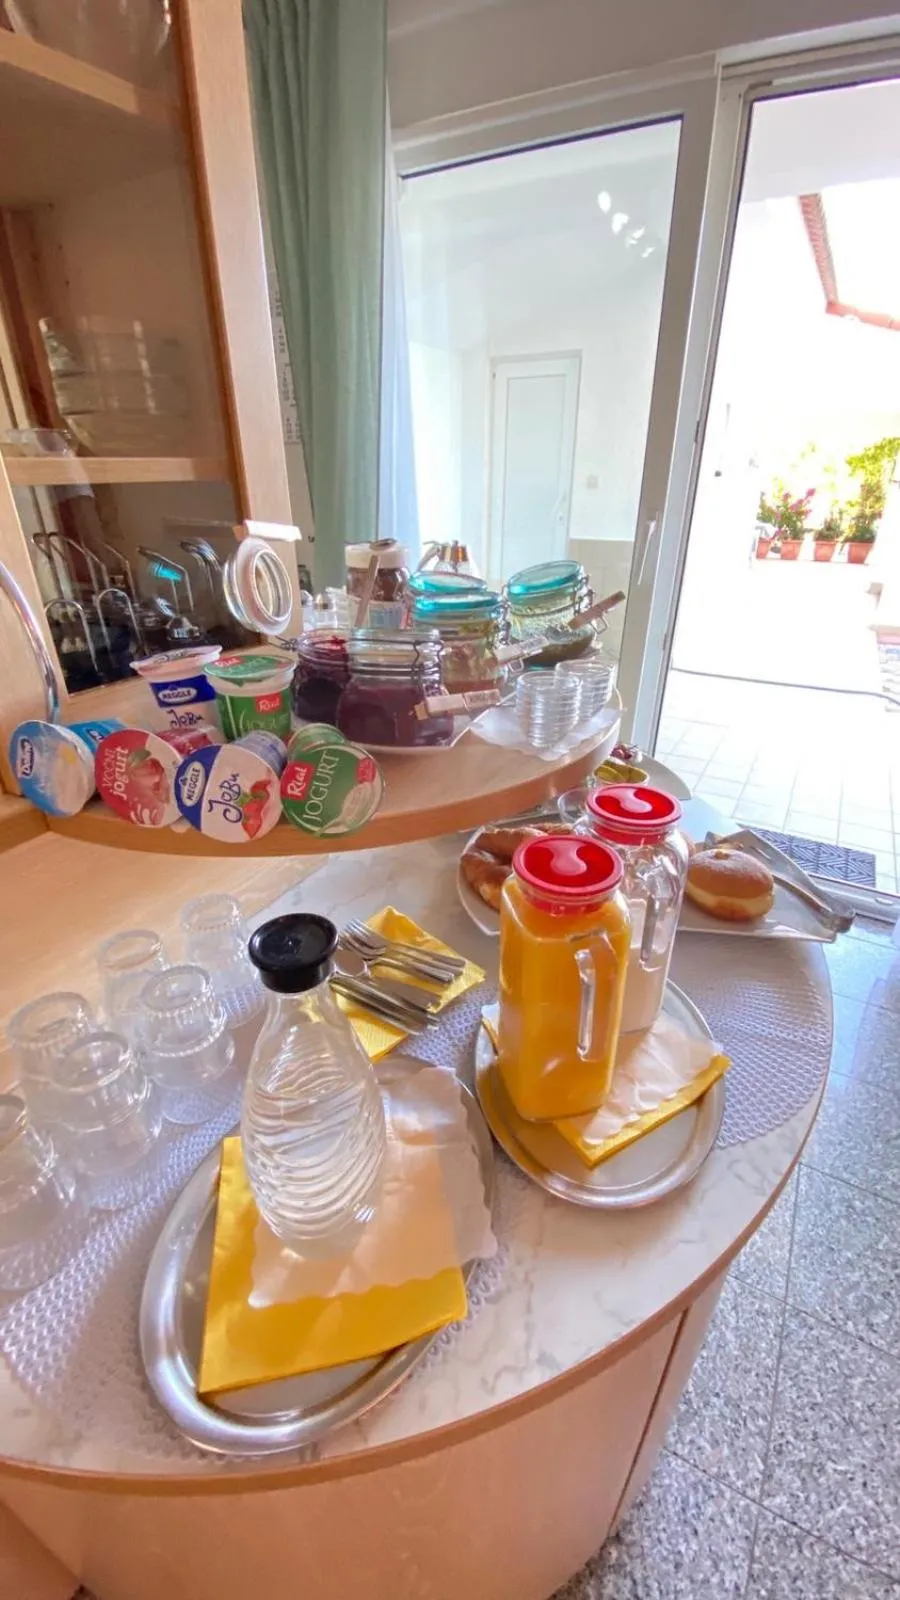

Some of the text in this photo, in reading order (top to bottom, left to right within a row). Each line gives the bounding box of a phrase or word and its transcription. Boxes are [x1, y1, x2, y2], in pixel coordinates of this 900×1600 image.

[109, 747, 129, 800] jogurt
[185, 766, 202, 802] MEGGLE
[303, 750, 340, 821] JOGURT
